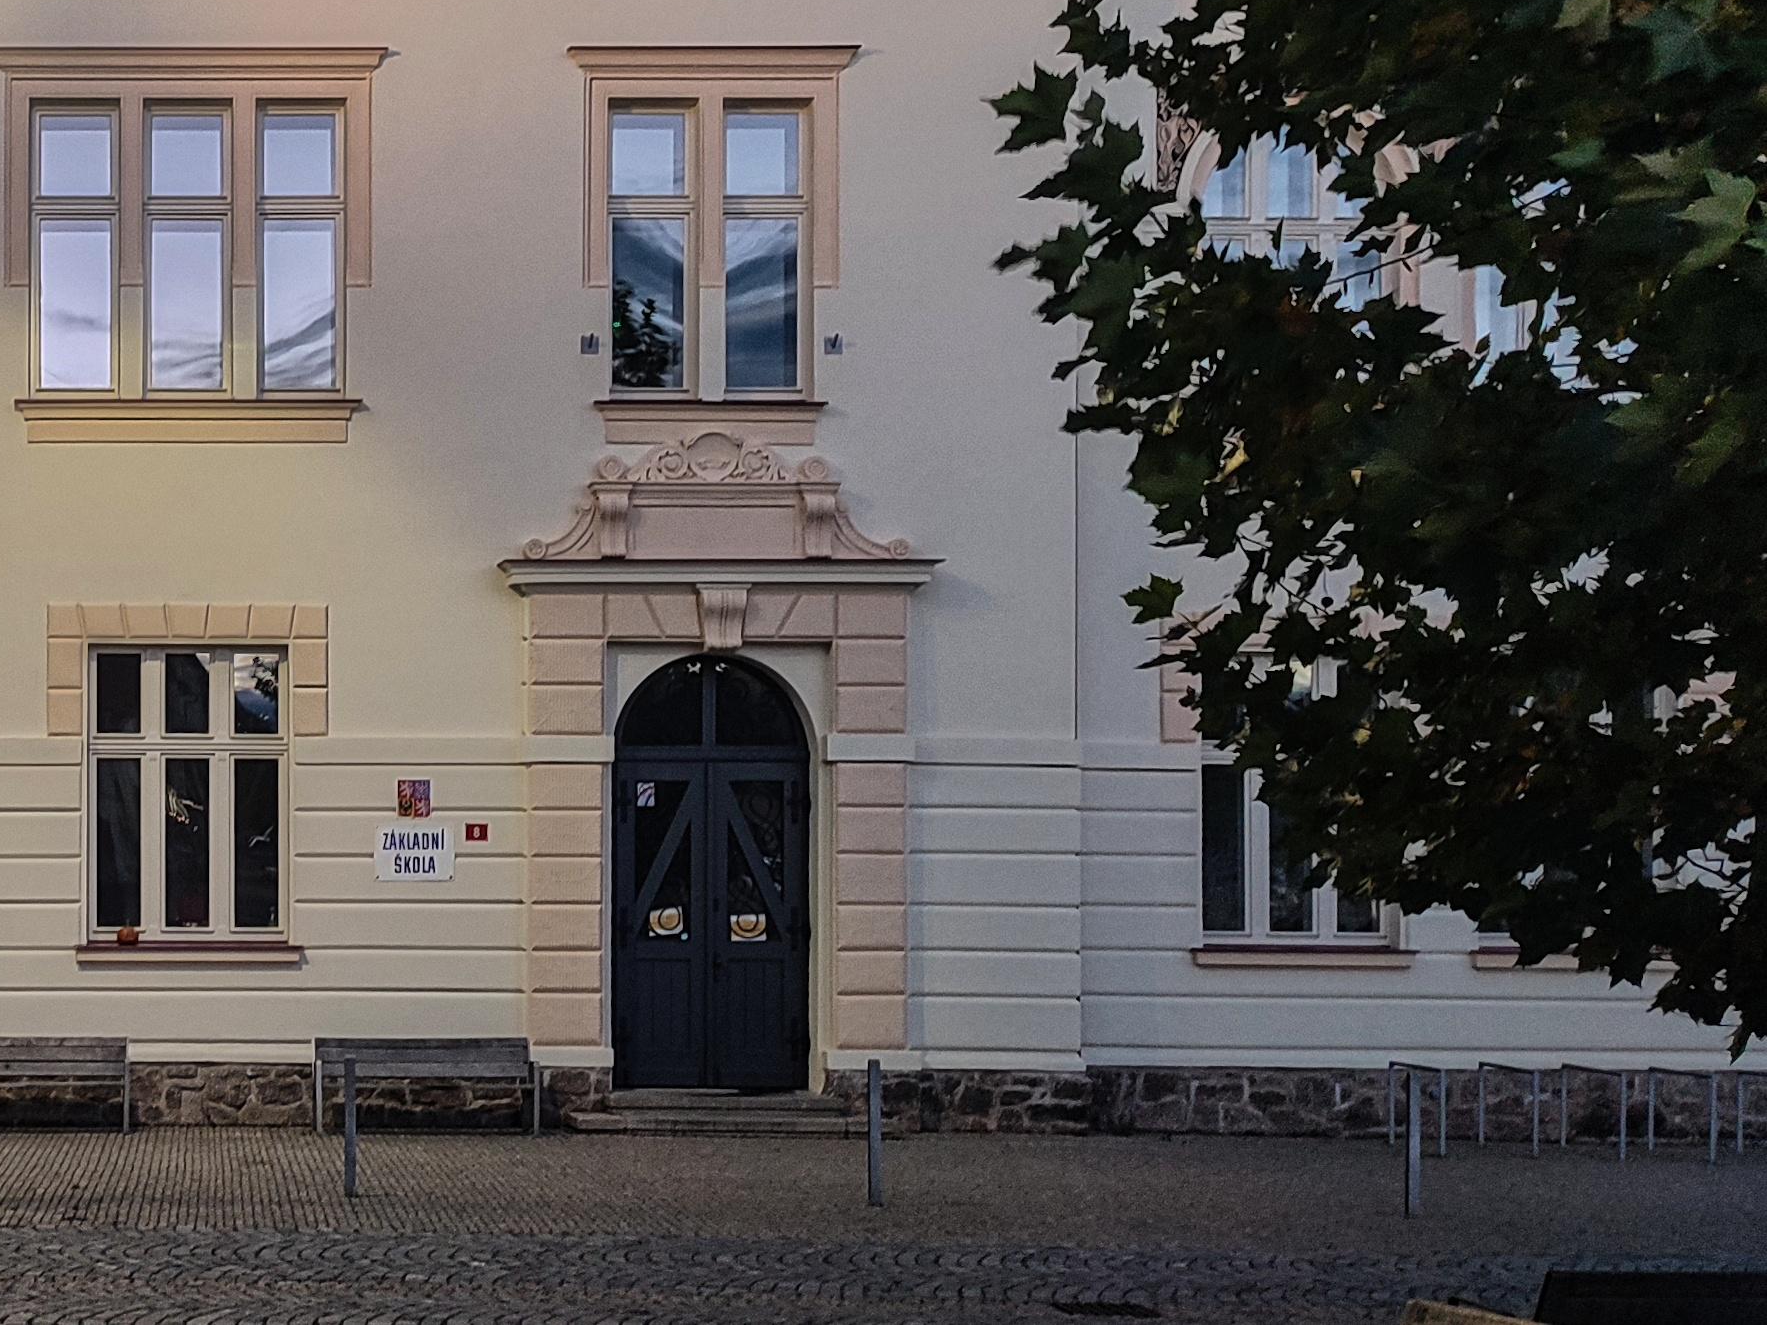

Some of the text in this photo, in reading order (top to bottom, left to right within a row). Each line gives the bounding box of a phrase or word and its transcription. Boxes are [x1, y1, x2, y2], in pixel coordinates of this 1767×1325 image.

[382, 828, 445, 850] ZÁKLADNÍ
[473, 826, 481, 838] 8
[394, 853, 436, 874] ŠKOLA
